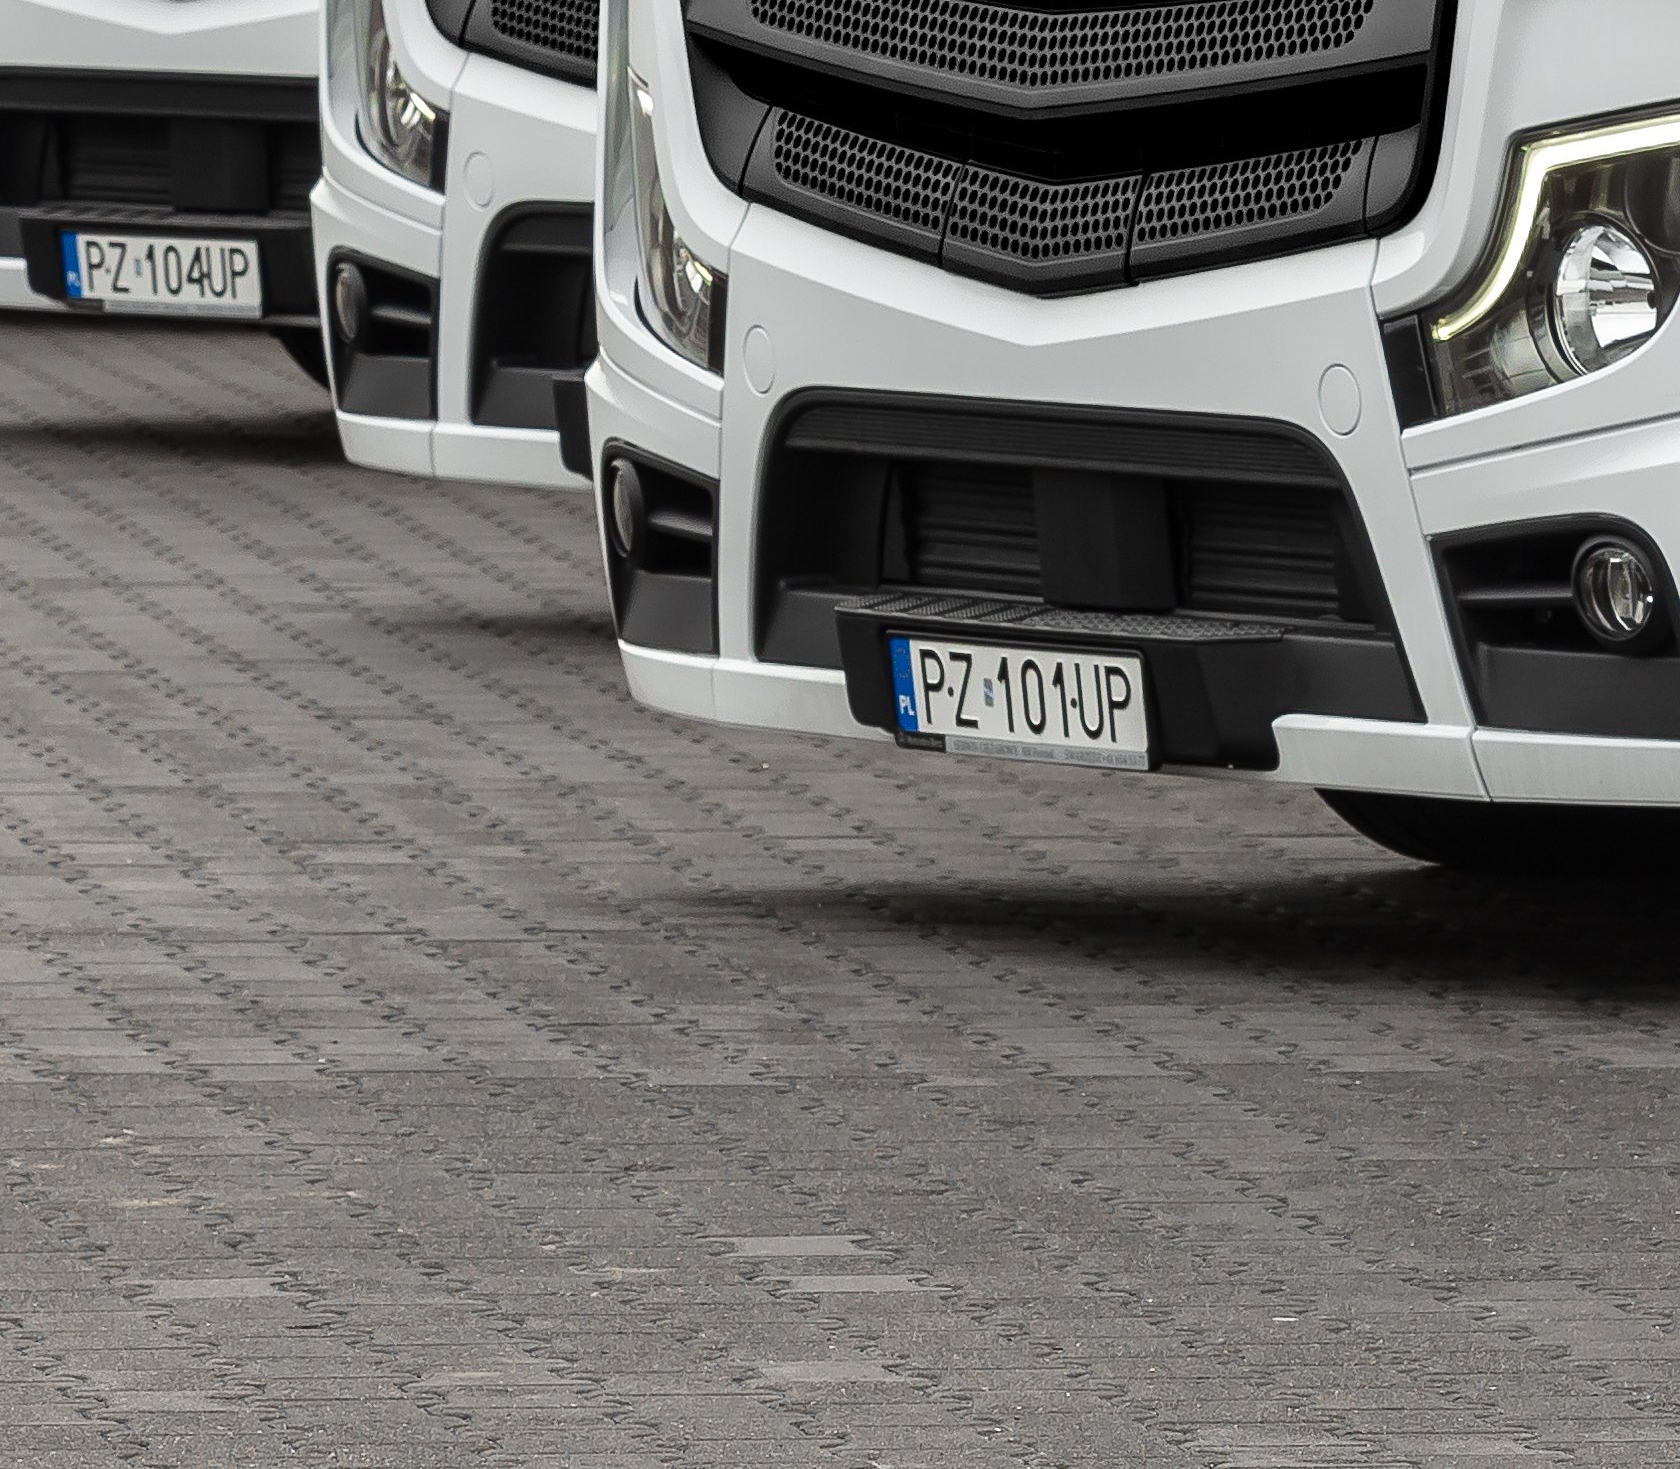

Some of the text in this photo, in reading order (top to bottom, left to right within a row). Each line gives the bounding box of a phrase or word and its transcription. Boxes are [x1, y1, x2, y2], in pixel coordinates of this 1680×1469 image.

[85, 239, 250, 300] PZ 104UP
[920, 648, 1132, 744] PZ 101UP
